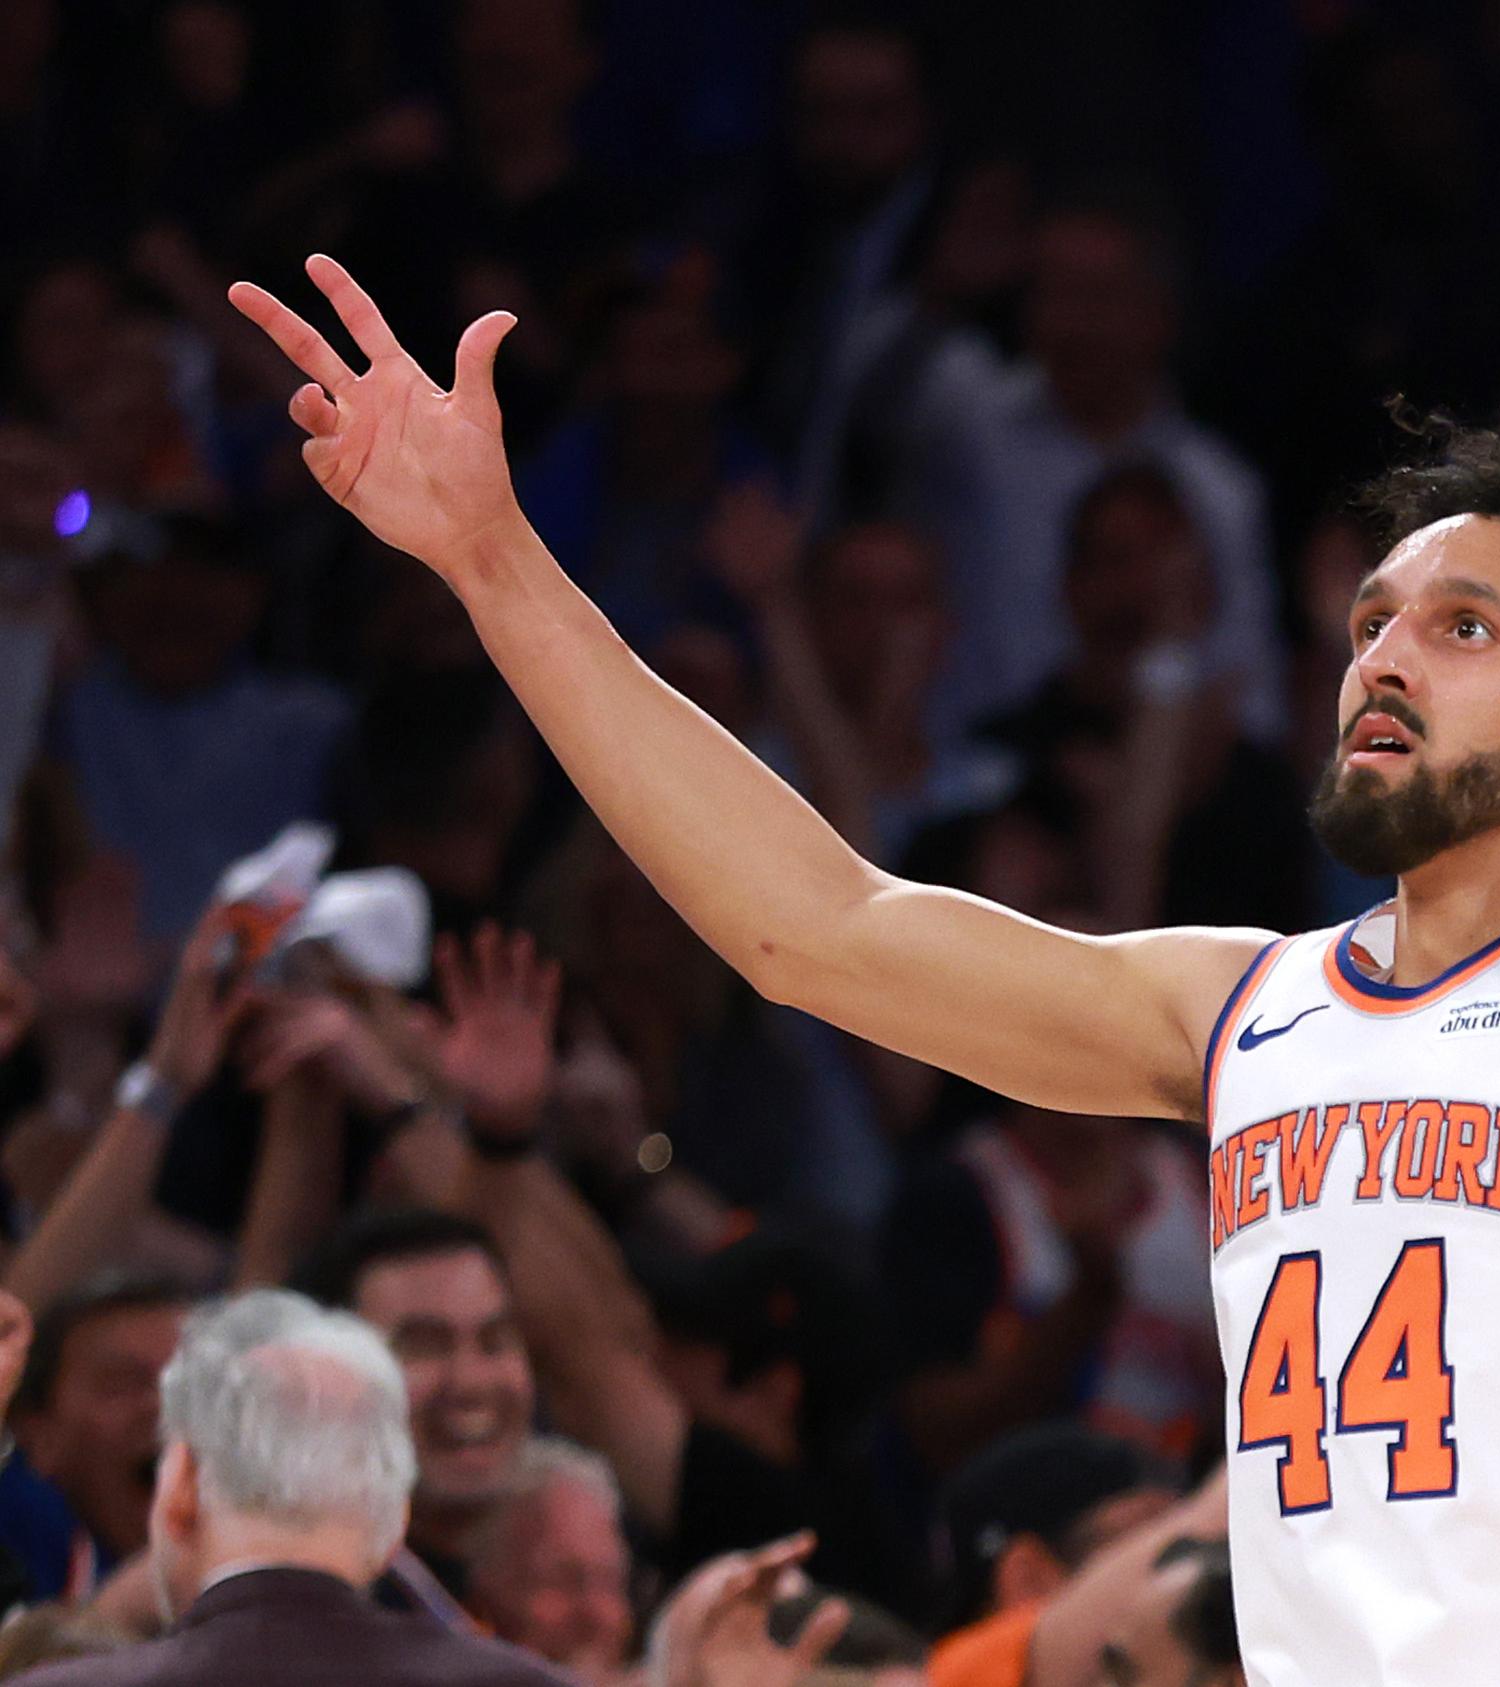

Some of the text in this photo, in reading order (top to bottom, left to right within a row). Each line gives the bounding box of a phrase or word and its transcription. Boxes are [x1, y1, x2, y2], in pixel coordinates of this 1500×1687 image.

[1440, 1015, 1479, 1033] abu
[1211, 1102, 1351, 1254] NEW
[1237, 1237, 1458, 1517] 44
